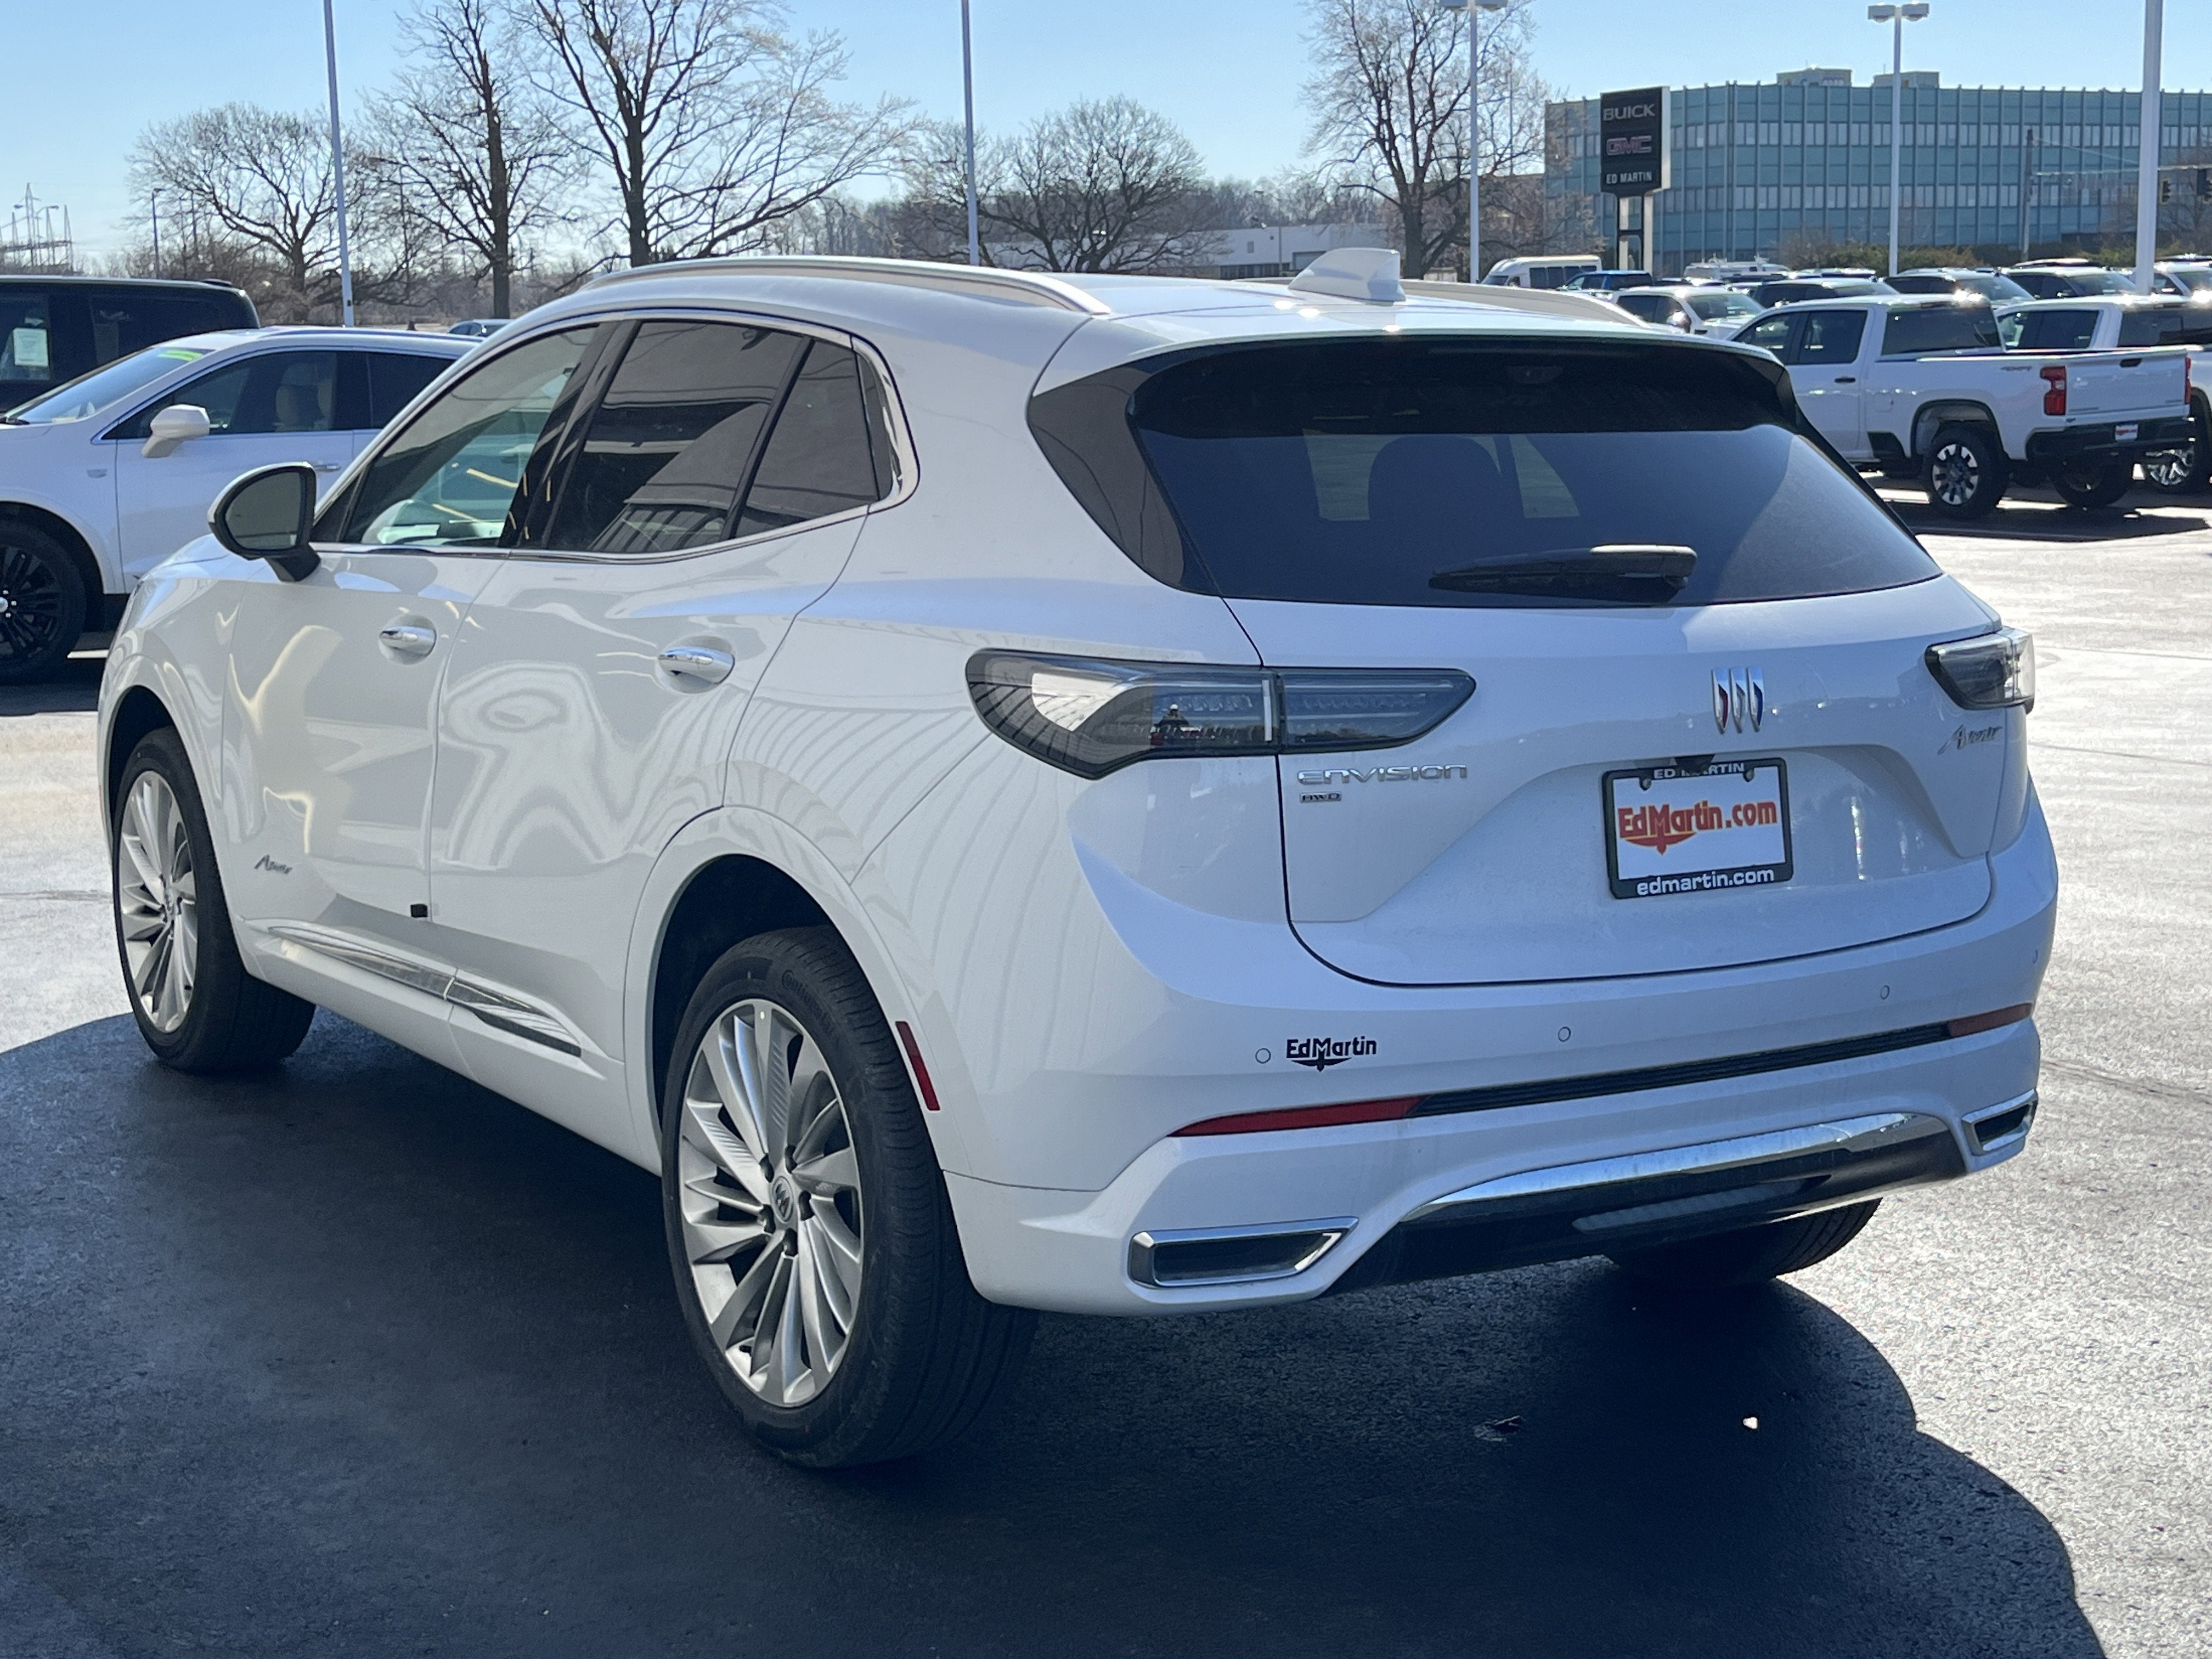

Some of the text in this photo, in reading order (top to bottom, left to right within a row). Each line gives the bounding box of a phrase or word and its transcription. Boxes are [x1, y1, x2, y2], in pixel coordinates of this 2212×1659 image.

[1602, 104, 1655, 121] BUICK
[1606, 136, 1652, 156] GMC
[1606, 171, 1652, 184] ED MARTIN
[1297, 764, 1468, 785] ENVISION
[1654, 769, 1675, 778] ED
[1301, 792, 1341, 802] AWD
[1618, 800, 1778, 839] EdMartin.com
[1637, 868, 1775, 896] edmartin.com
[1286, 1036, 1377, 1058] EdMartin
